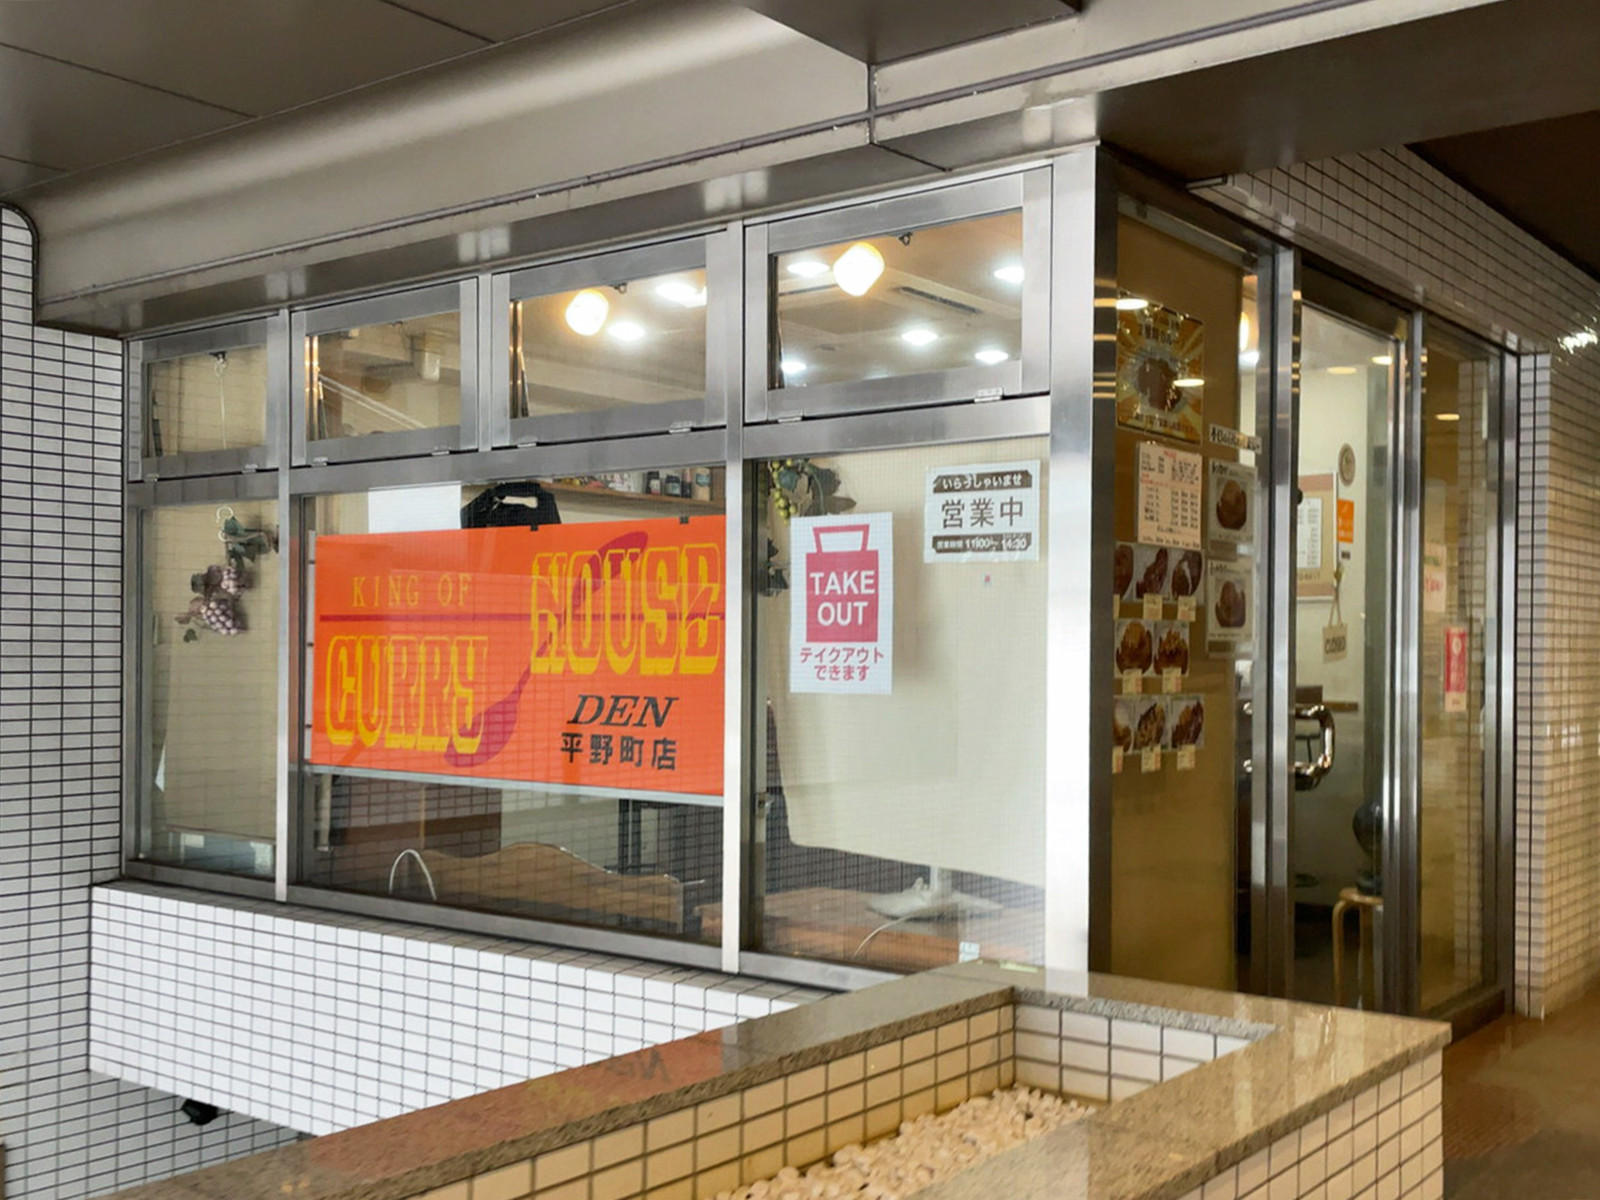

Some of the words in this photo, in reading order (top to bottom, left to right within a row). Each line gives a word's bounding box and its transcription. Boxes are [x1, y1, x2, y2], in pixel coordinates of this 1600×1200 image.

[942, 473, 1022, 490] いらっしゃいませ
[941, 496, 1024, 529] 営業中
[352, 574, 419, 607] KING
[438, 572, 472, 607] OF
[809, 570, 875, 596] TAKE
[531, 542, 720, 676] HOUSE
[817, 602, 868, 626] OUT
[800, 647, 884, 664] テイクアウト
[814, 664, 870, 681] できます
[325, 635, 488, 754] CURRY
[566, 694, 679, 728] DEN
[560, 732, 677, 771] 平野町店
